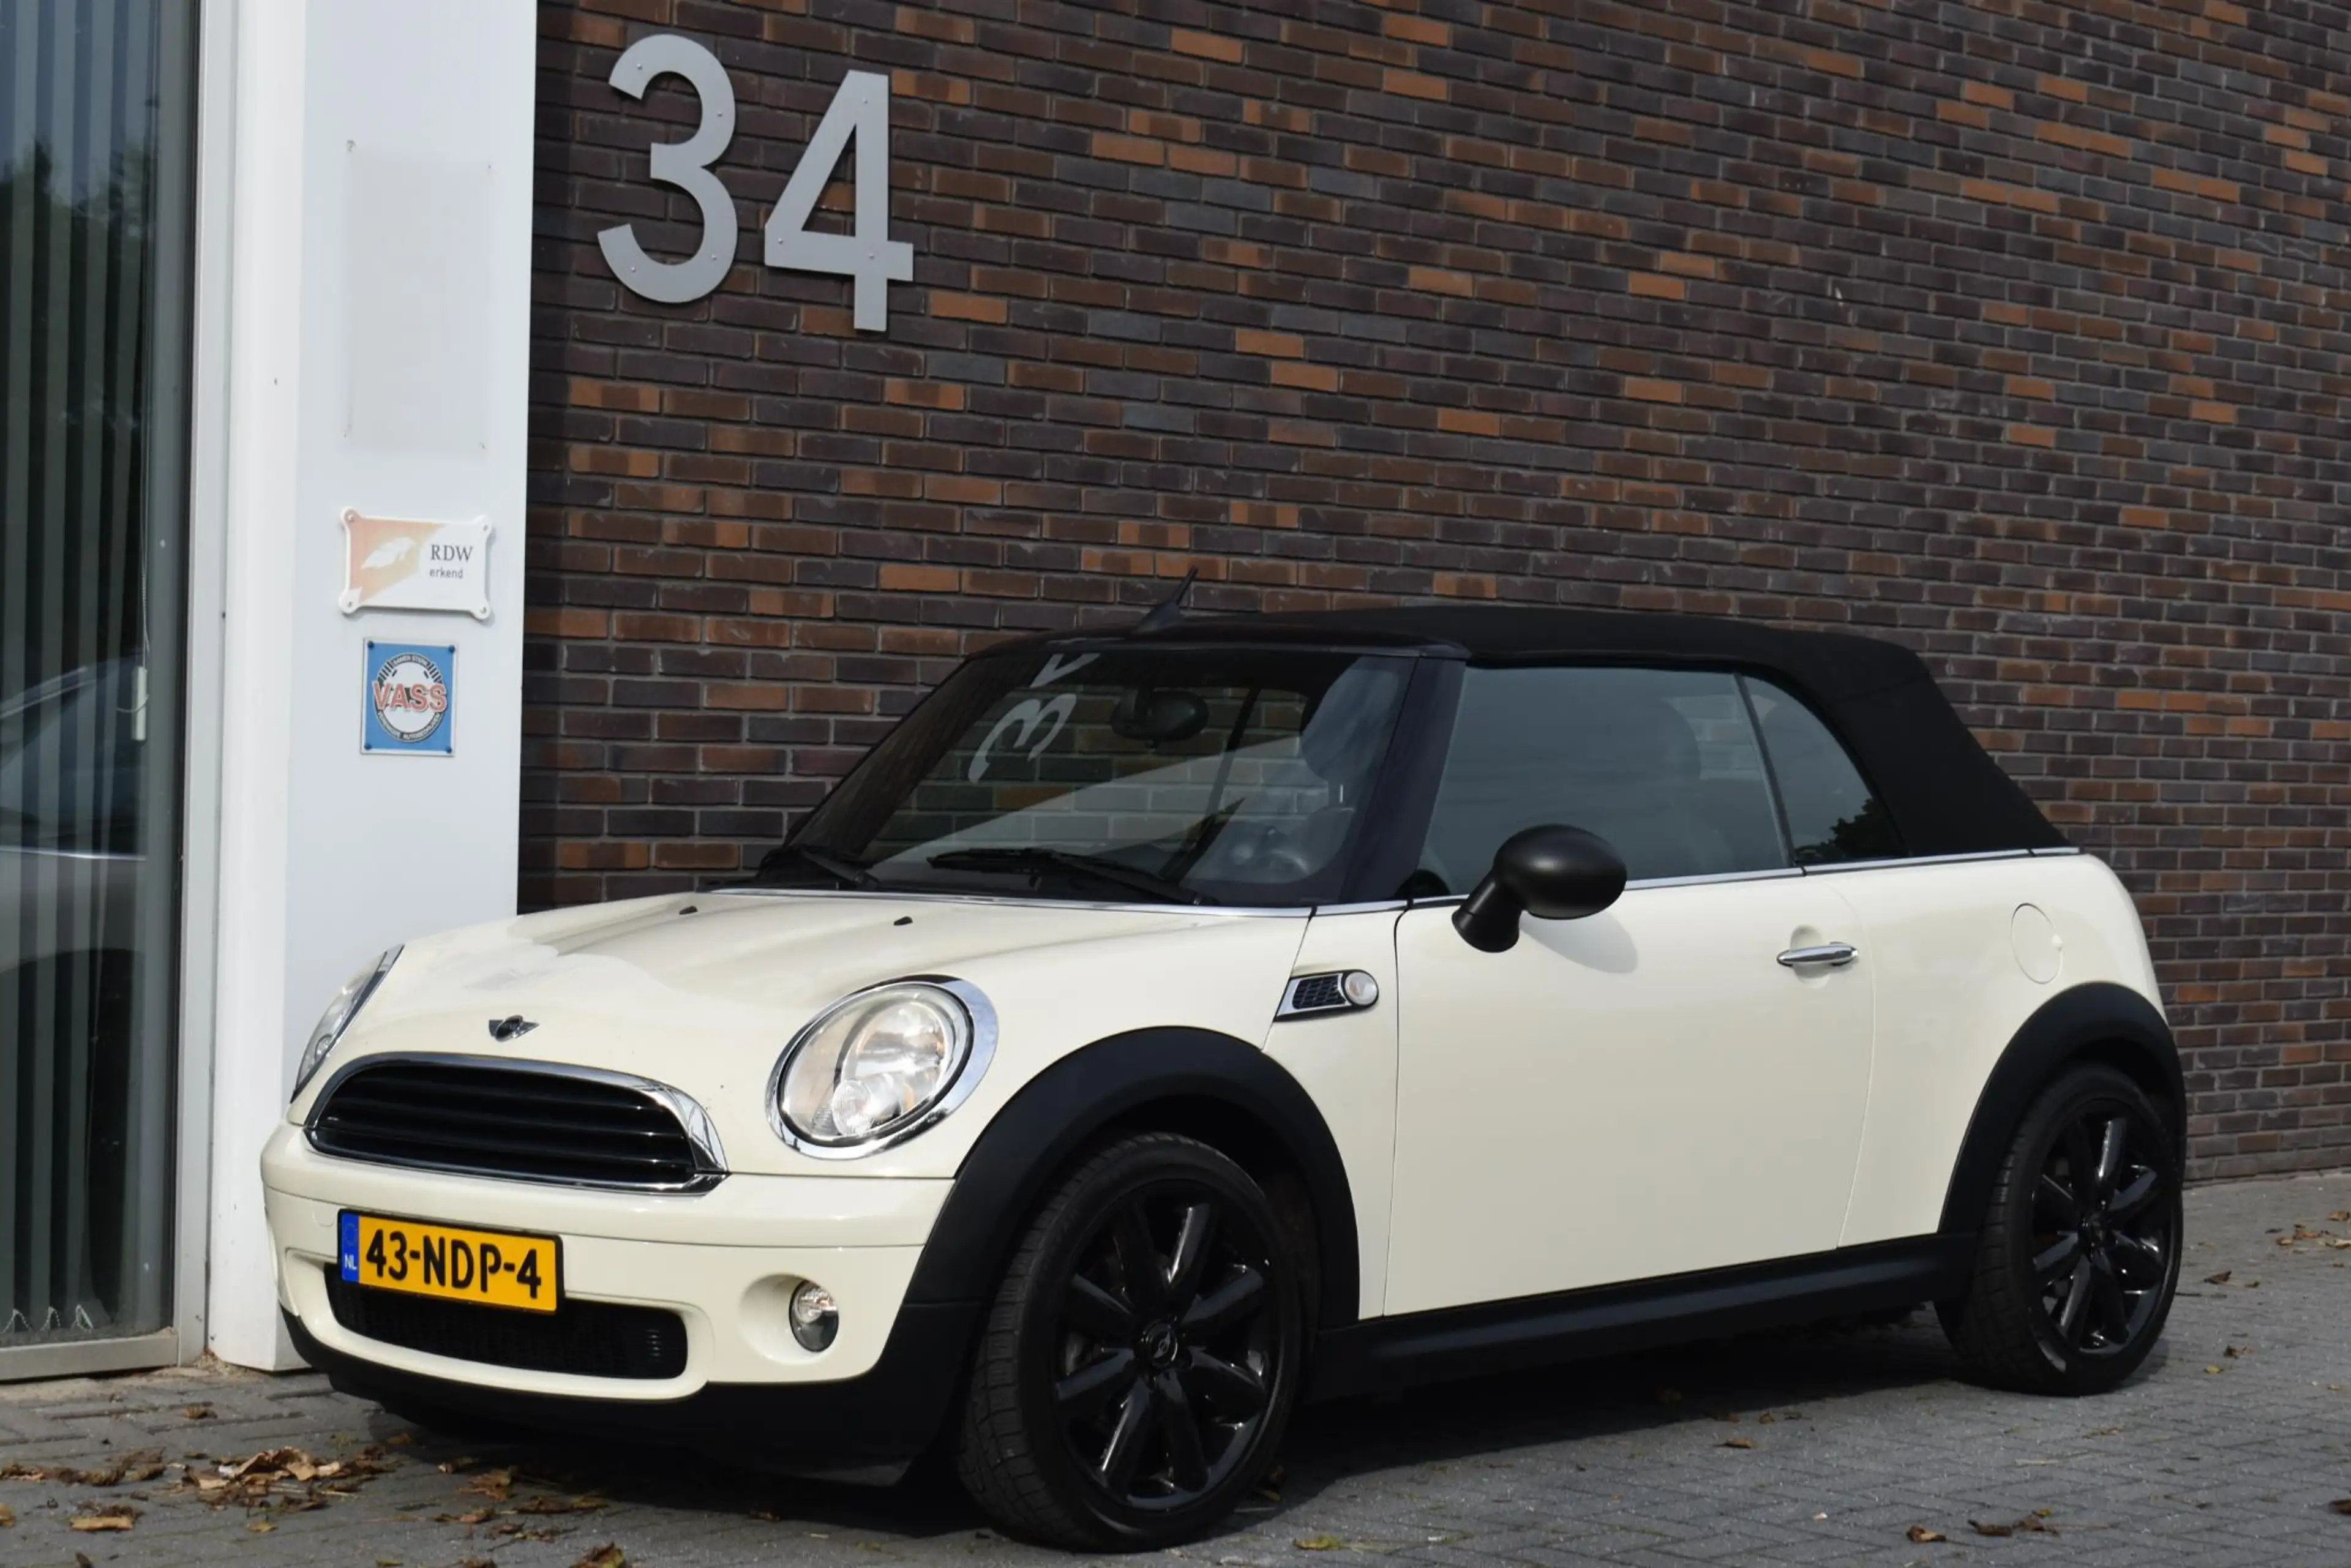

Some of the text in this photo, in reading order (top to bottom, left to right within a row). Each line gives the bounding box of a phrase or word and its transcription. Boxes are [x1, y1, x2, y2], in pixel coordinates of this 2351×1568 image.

[598, 34, 913, 332] 34
[431, 544, 473, 563] RDW
[430, 566, 463, 579] erkend
[372, 680, 448, 713] VASS
[344, 1253, 357, 1270] NL
[366, 1228, 542, 1299] 43-NDP-4
